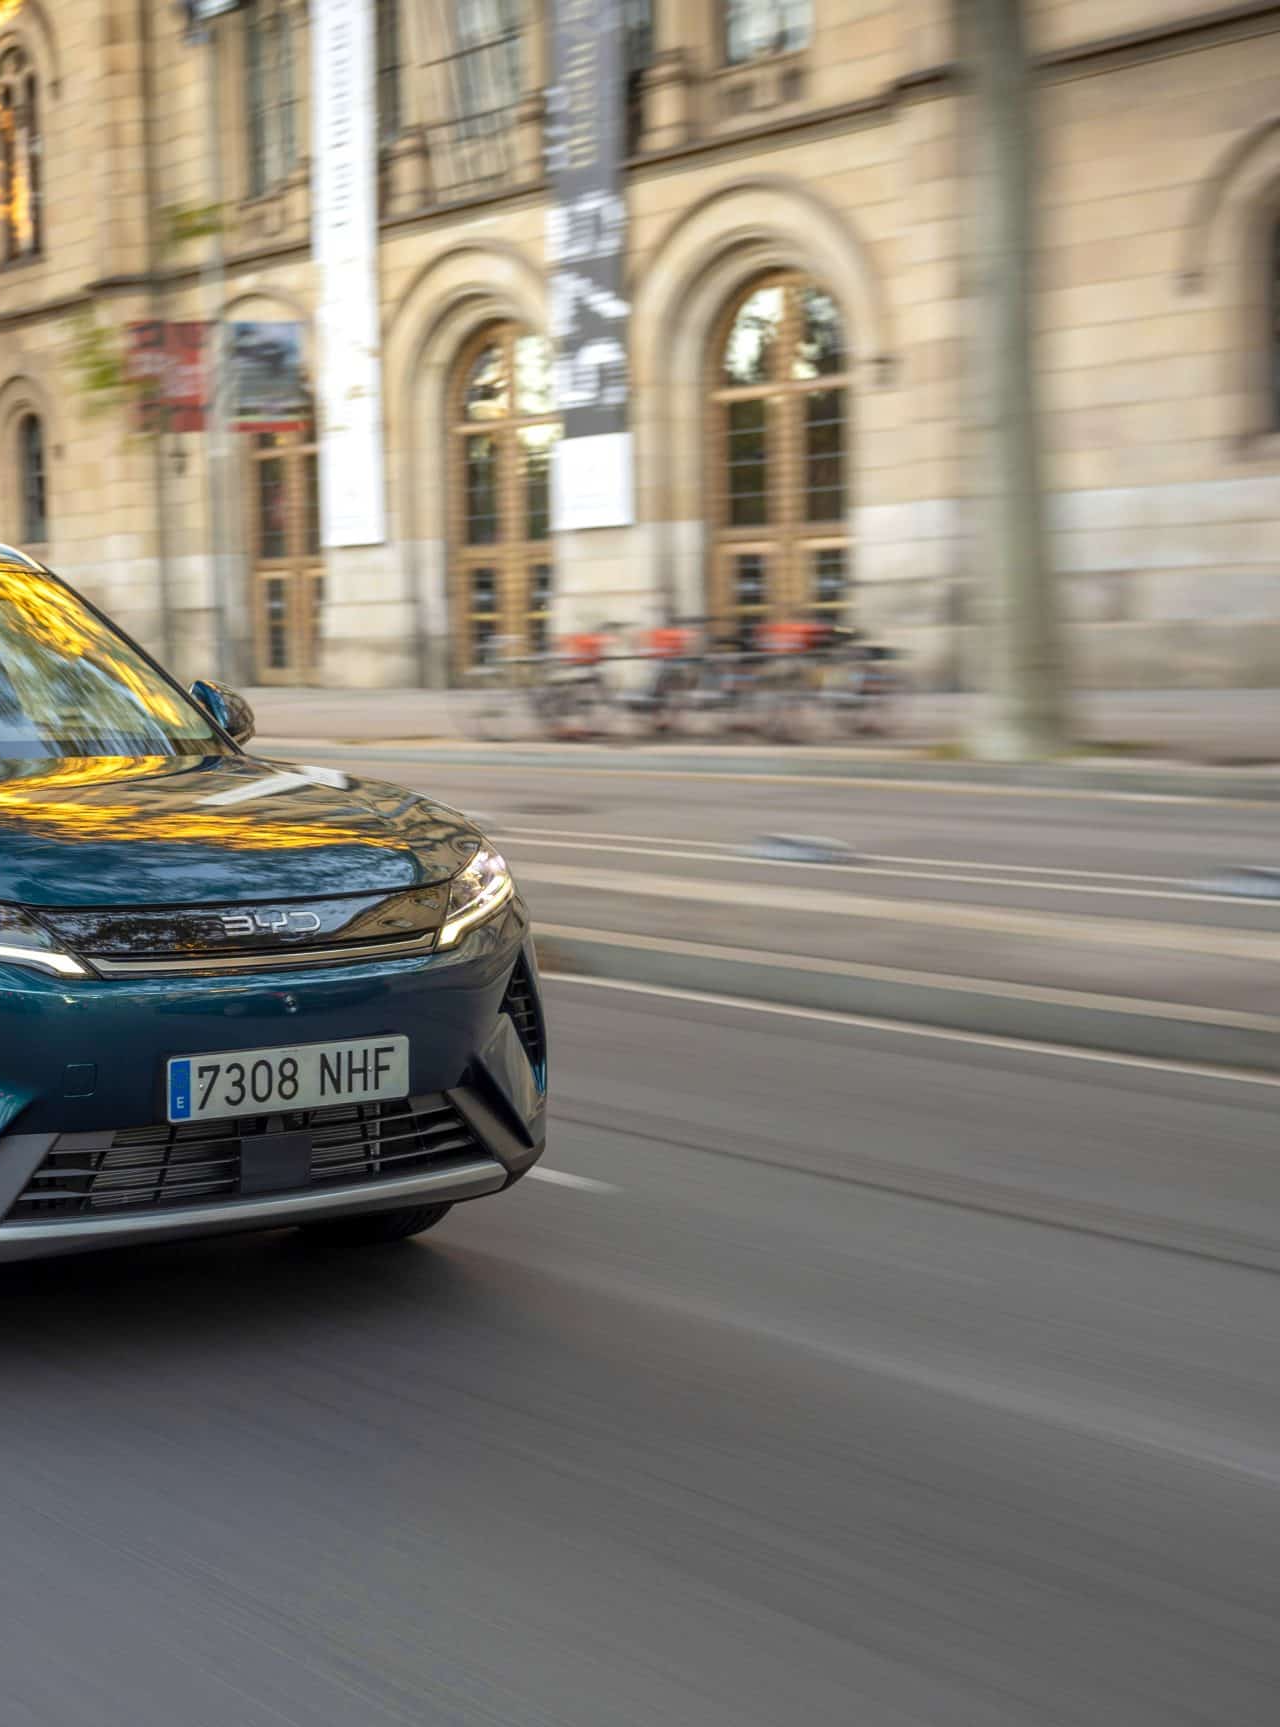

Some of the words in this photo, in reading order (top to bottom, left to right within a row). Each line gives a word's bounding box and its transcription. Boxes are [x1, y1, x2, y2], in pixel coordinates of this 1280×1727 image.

[221, 911, 321, 937] BYD
[198, 1057, 299, 1111] 7308
[320, 1046, 395, 1096] NHF
[176, 1096, 185, 1109] E
